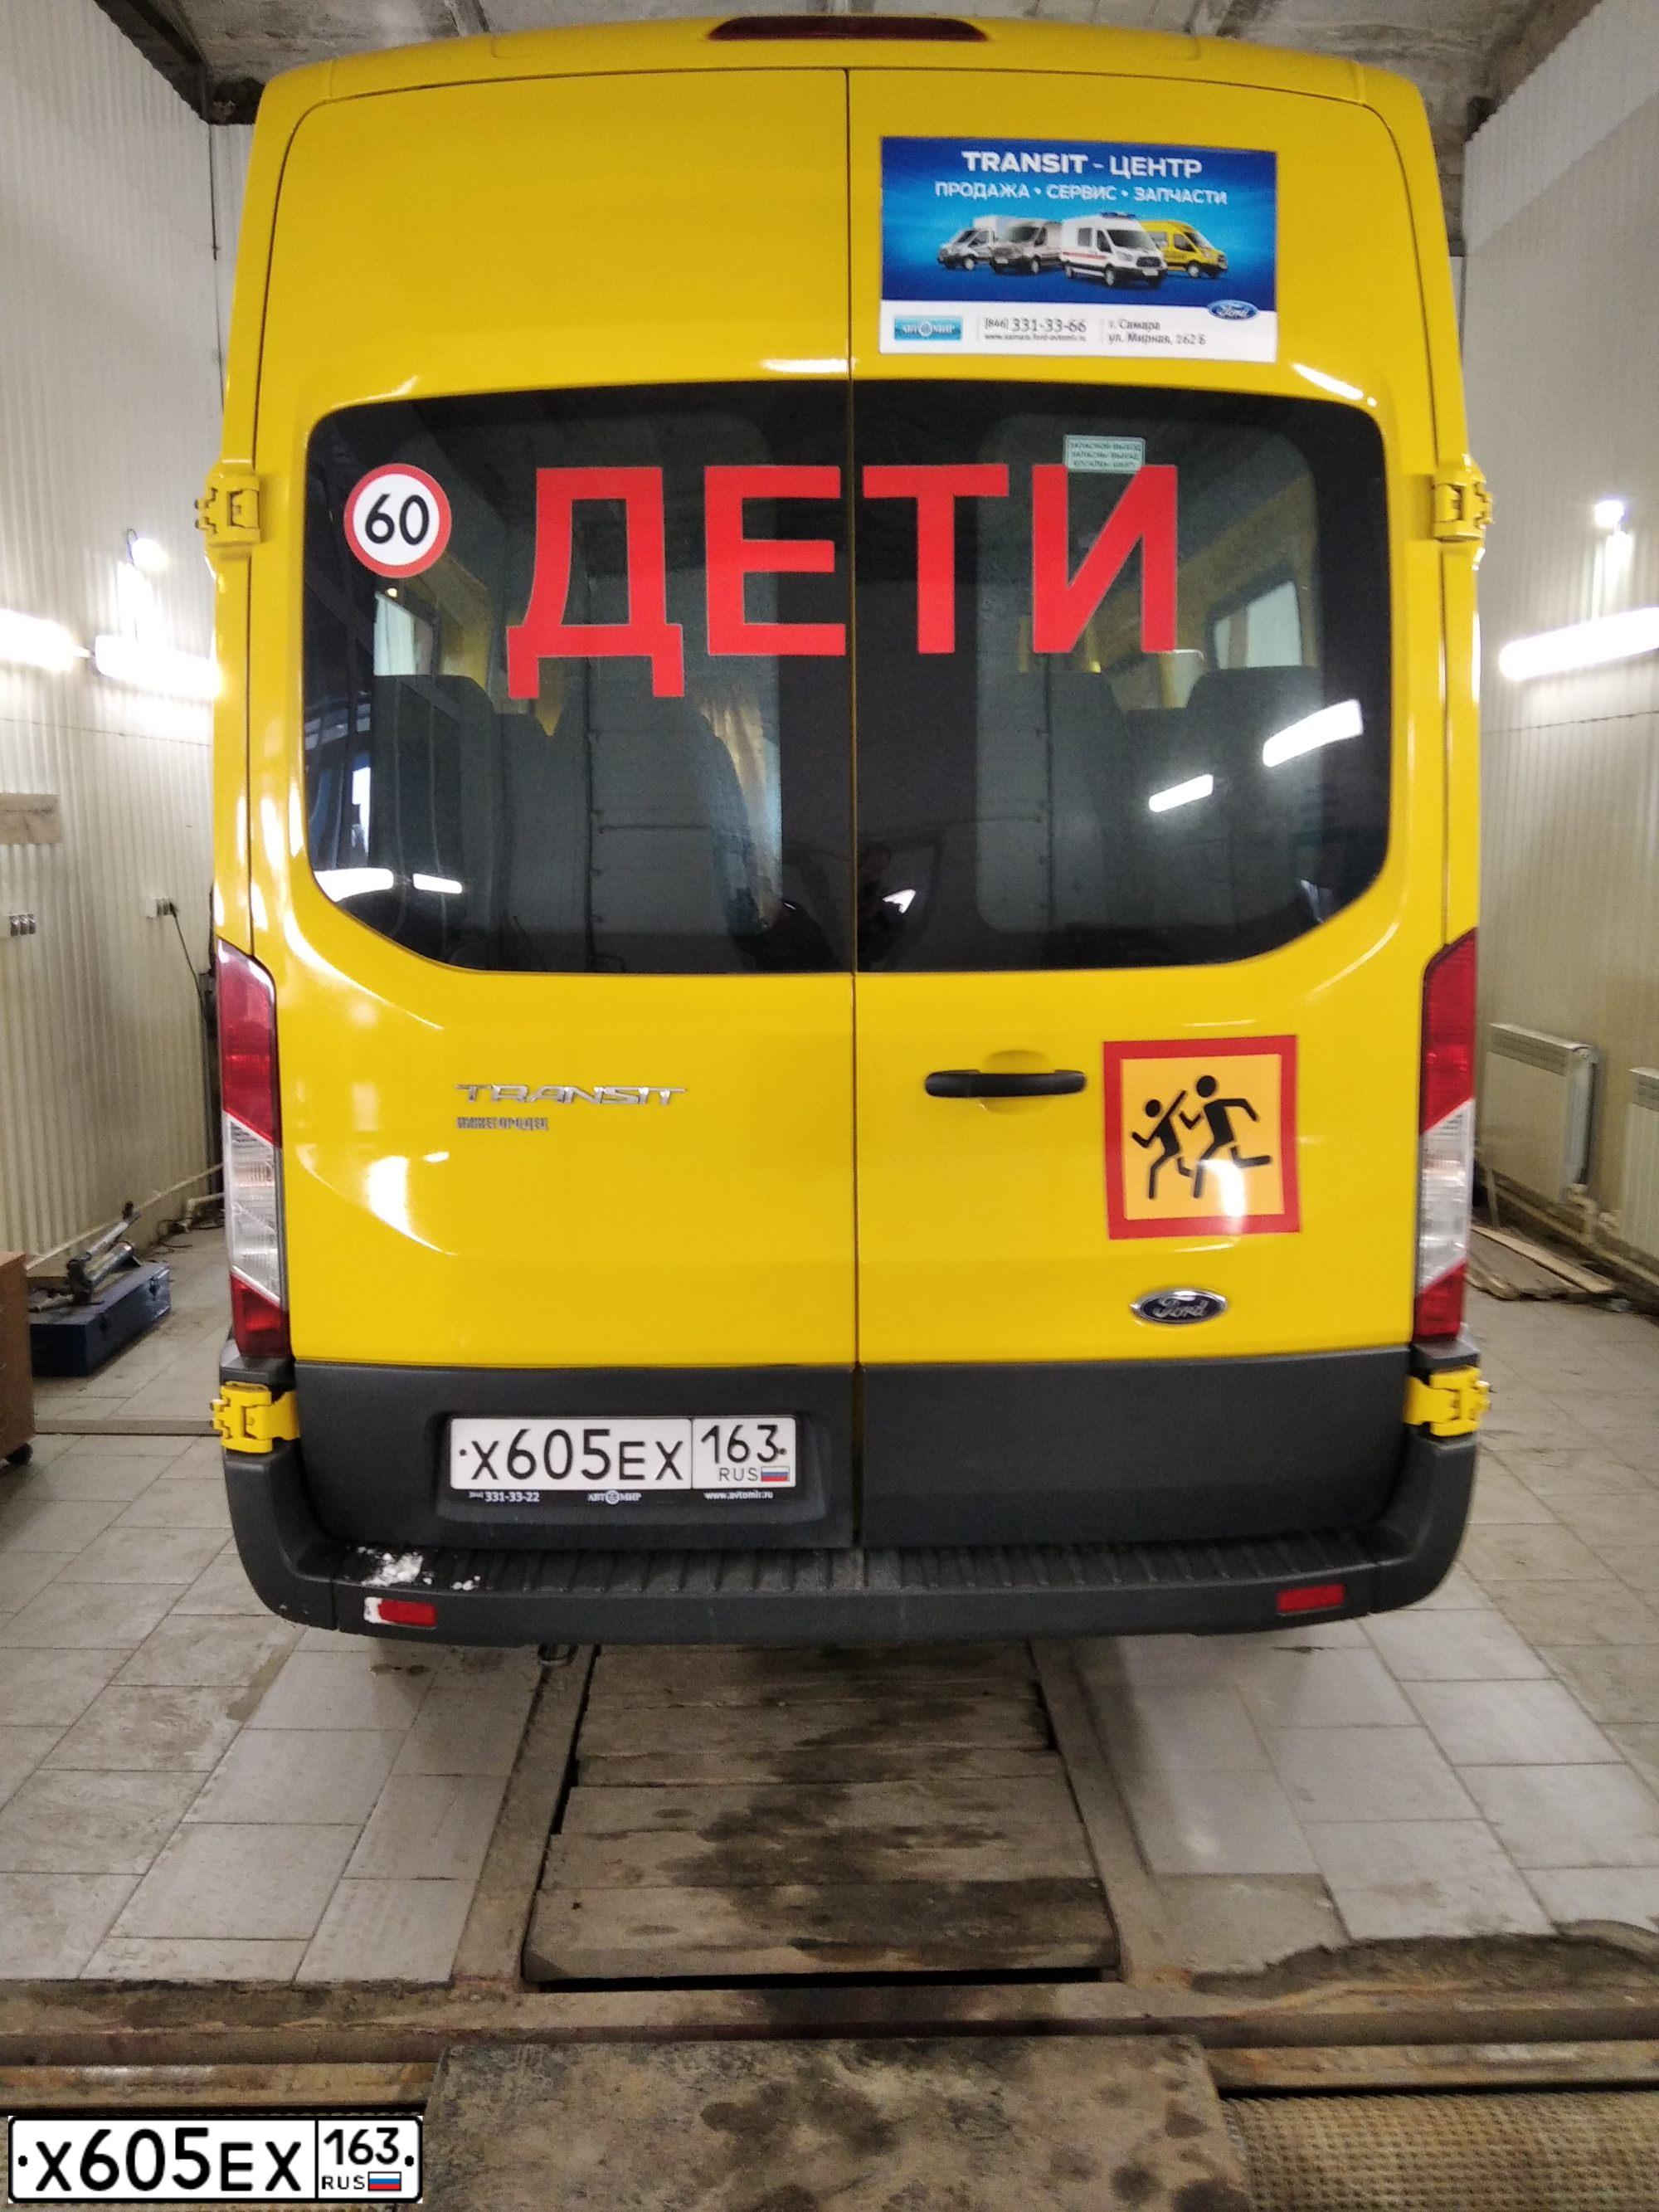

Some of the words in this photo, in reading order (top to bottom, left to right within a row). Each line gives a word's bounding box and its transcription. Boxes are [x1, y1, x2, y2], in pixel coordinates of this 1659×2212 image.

[961, 151, 1088, 173] TRANSIT
[1109, 154, 1203, 179] ЦЕНТР
[934, 181, 1030, 201] ПРОДАЖА
[1046, 183, 1117, 202] СЕРВИС
[1133, 185, 1228, 206] ЗАПЧАСТИ
[1011, 317, 1087, 333] 331-33-66
[1119, 318, 1161, 332] Самара
[364, 494, 430, 546] 60
[506, 464, 1178, 699] ДЕТИ
[455, 1084, 686, 1105] TRANSIT
[1152, 1296, 1209, 1318] Ford
[701, 1424, 777, 1464] 163
[718, 1467, 758, 1482] RUS
[484, 1491, 540, 1503] 331-33-22
[703, 1490, 774, 1500] www.avtomir.ru
